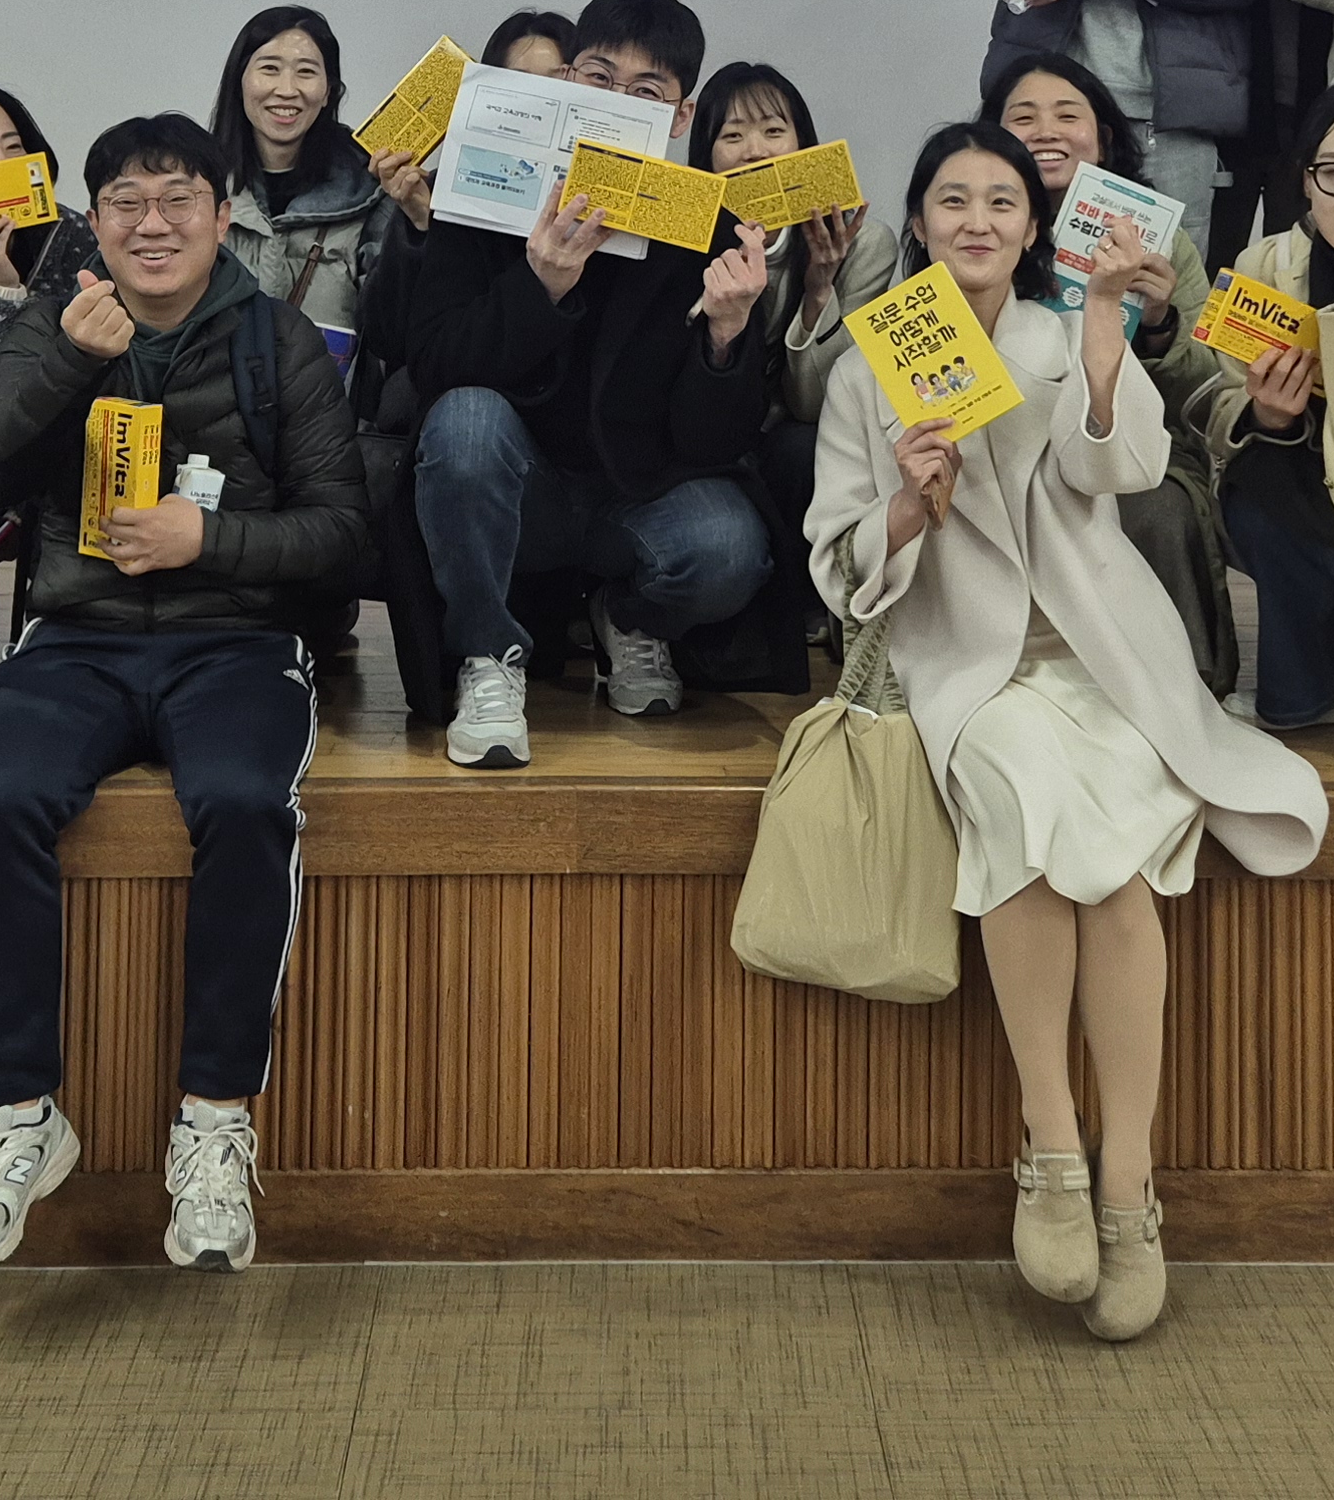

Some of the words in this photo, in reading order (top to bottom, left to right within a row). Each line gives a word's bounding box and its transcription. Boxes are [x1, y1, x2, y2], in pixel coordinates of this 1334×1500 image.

[1075, 200, 1101, 221] 캔바
[867, 302, 905, 335] 질문
[904, 282, 938, 312] 수업
[889, 309, 940, 347] 어떻게
[893, 324, 959, 372] 시작할까
